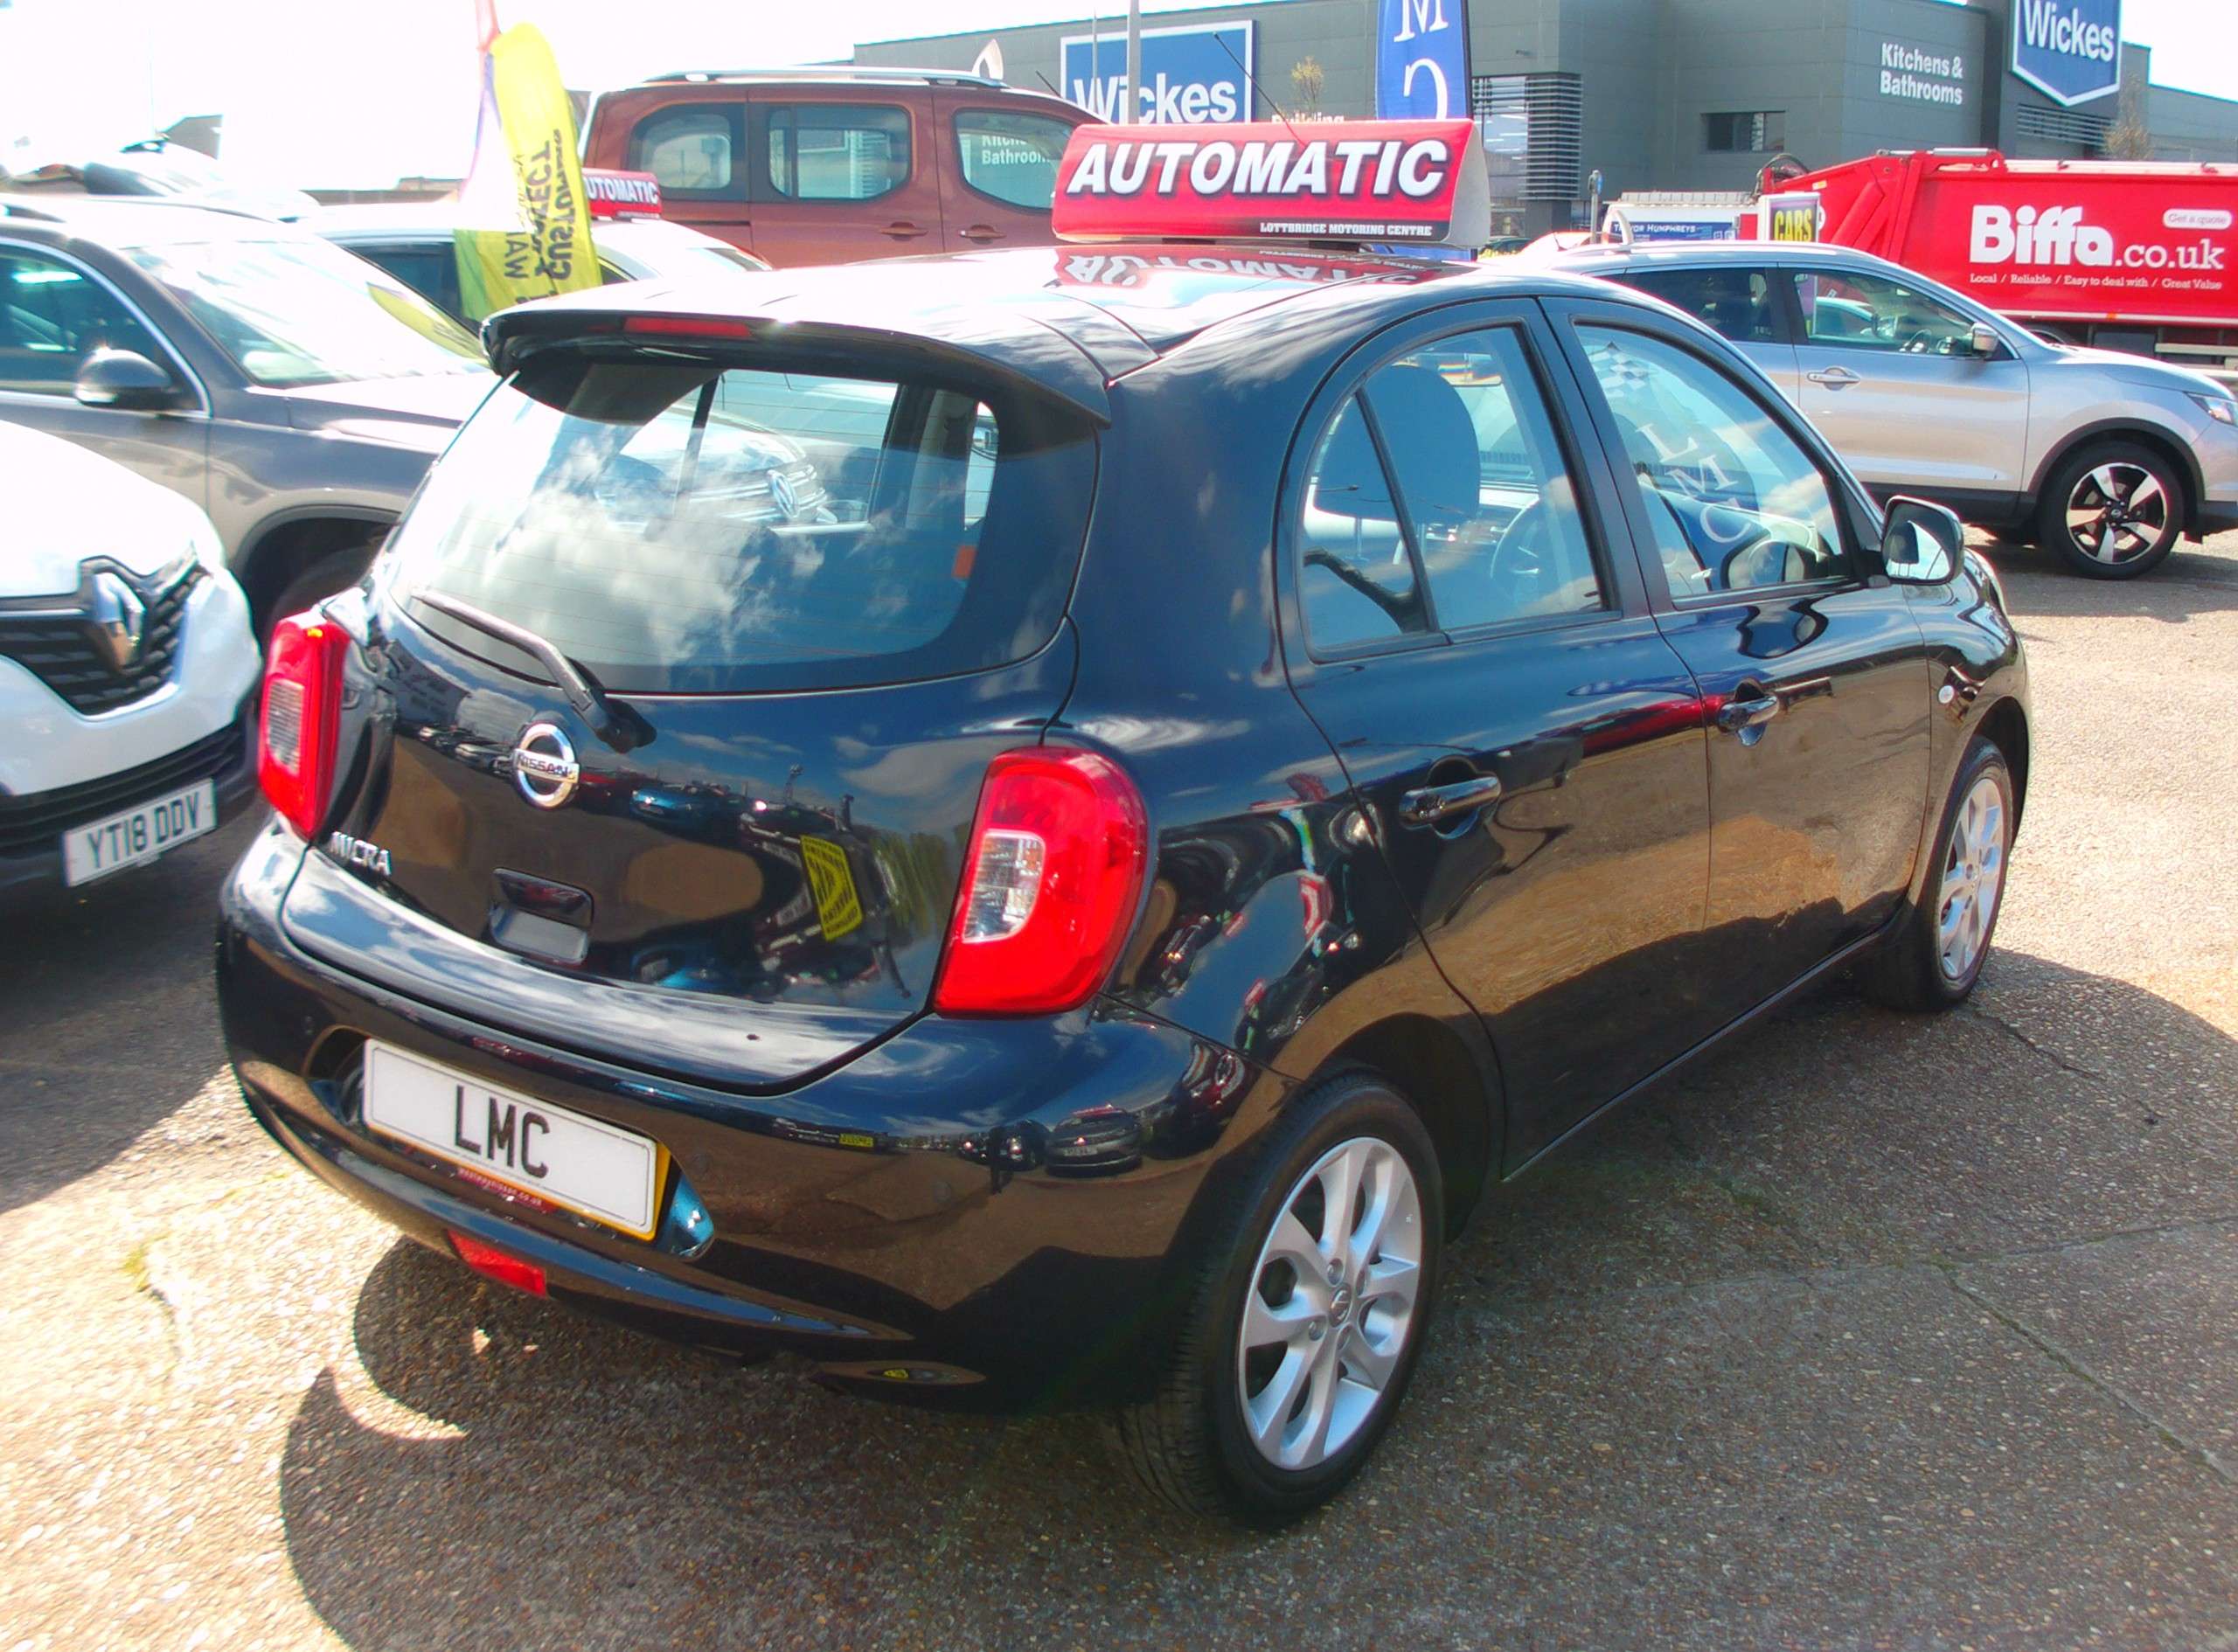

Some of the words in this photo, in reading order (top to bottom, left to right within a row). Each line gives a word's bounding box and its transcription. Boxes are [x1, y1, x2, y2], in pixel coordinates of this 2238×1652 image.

[2023, 0, 2115, 62] Wickes
[1881, 43, 1950, 76] Kitchens
[1951, 56, 1963, 80] &
[1074, 73, 1236, 124] Wickes
[1880, 71, 1963, 105] Bathrooms
[982, 149, 1050, 164] Bathroo
[1066, 140, 1447, 197] AUTOMATIC
[583, 177, 658, 205] UTOMATIC
[1260, 222, 1327, 234] LOTTBRIDGE
[1328, 223, 1385, 235] MOTORING
[1387, 225, 1433, 237] CENTRE
[1774, 208, 1812, 242] CARS
[1970, 273, 1998, 284] Local
[2010, 273, 2053, 285] Reliable
[2064, 274, 2089, 288] Easy
[2090, 276, 2101, 287] to
[2102, 276, 2125, 287] deal
[2126, 277, 2149, 288] with
[2161, 278, 2191, 289] Great
[2193, 279, 2222, 290] Value
[518, 752, 569, 778] NISSAN
[87, 814, 148, 868] YT18
[154, 792, 199, 843] DDV
[330, 831, 392, 875] MICRA
[455, 1085, 551, 1179] LMC
